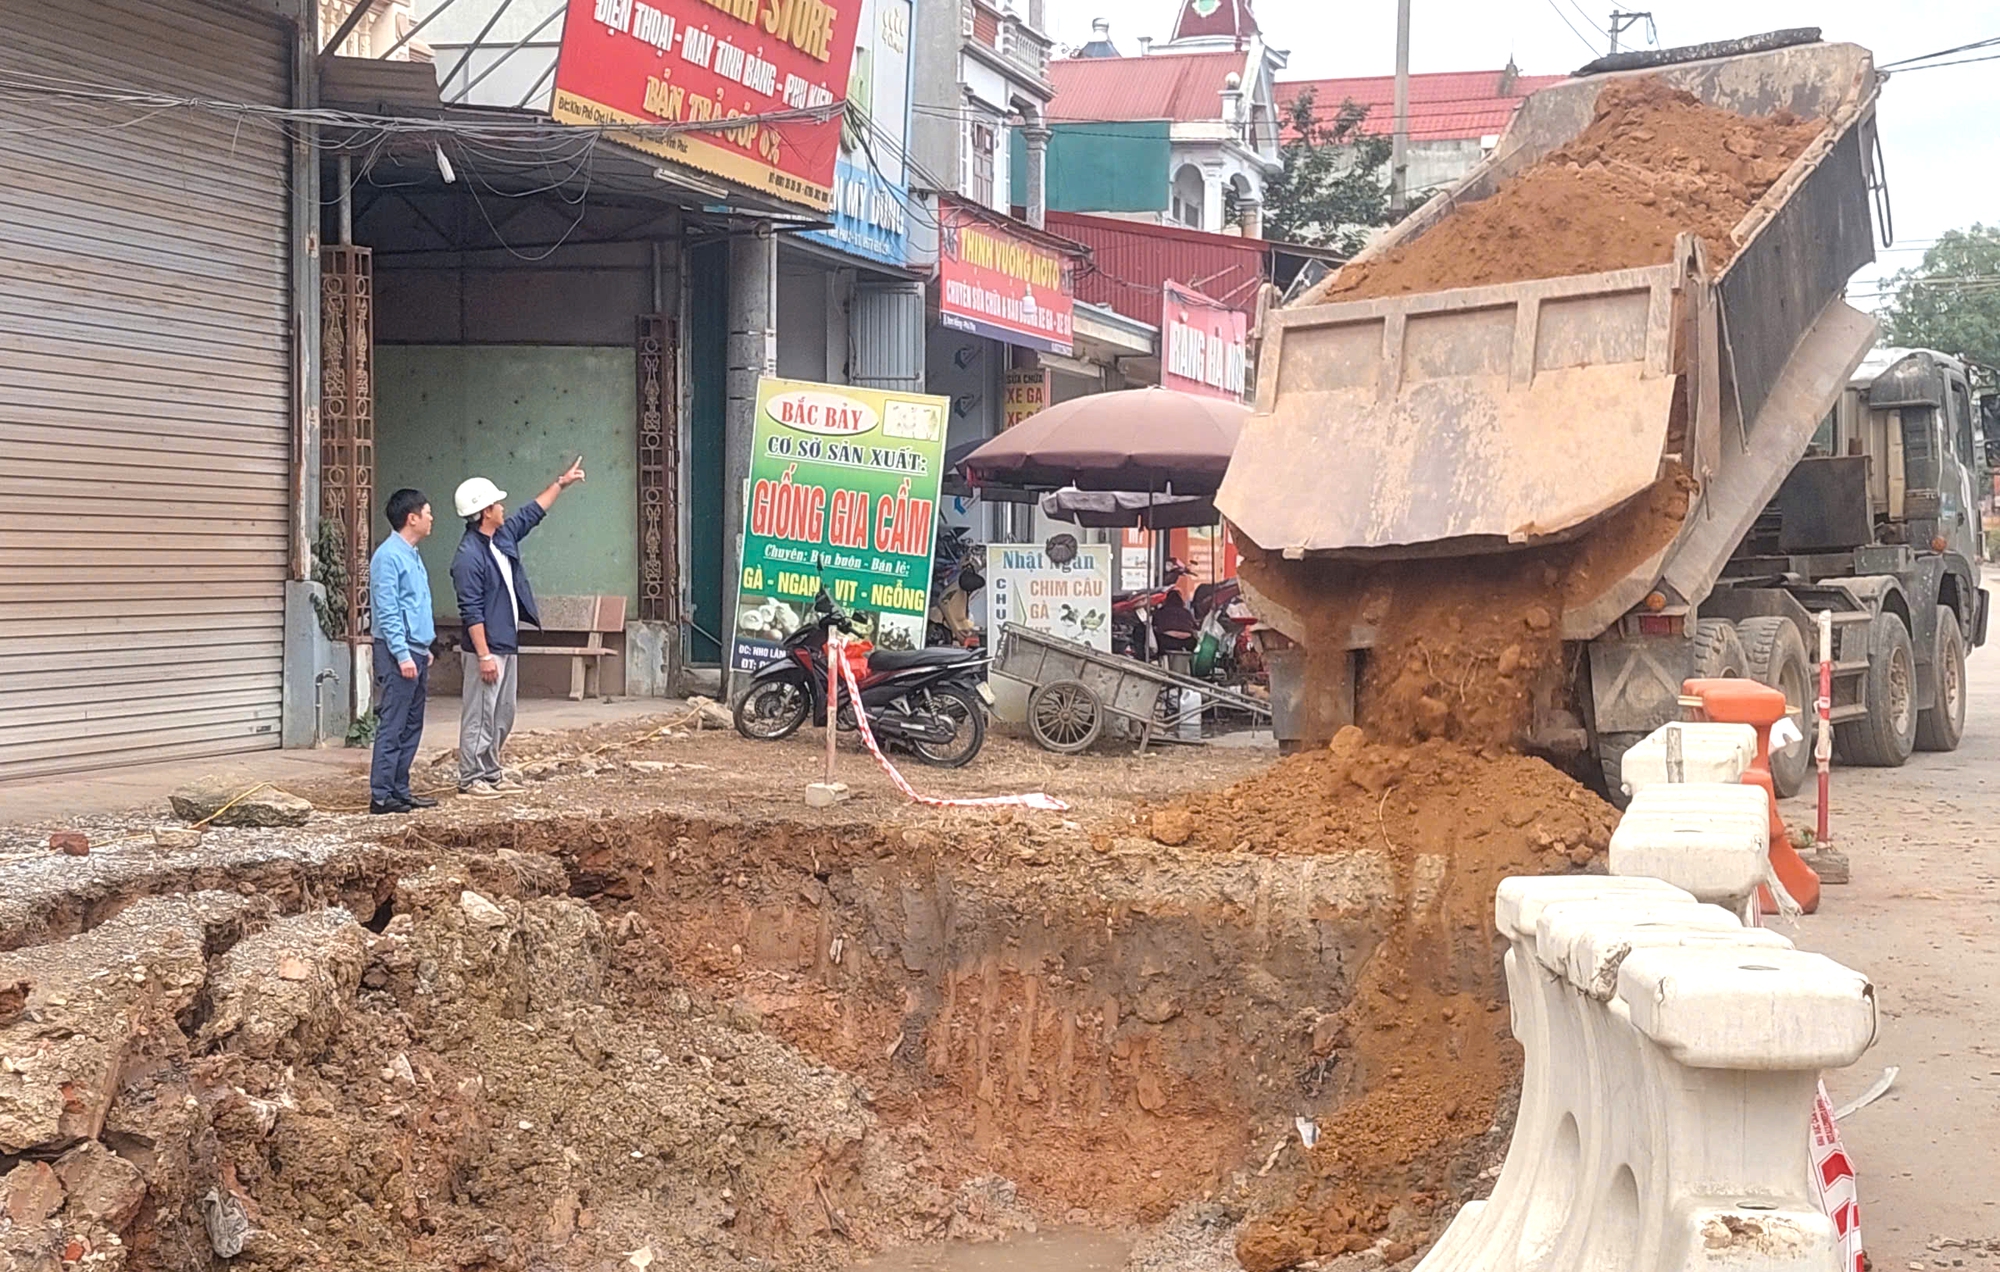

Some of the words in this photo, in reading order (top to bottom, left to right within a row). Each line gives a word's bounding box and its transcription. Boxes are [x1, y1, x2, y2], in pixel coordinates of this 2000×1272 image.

[631, 1, 676, 57] THOẠI
[681, 24, 715, 69] MÁY
[714, 35, 745, 82] TÍNH
[742, 46, 777, 97] BẢNG
[961, 227, 994, 275] THỊNH
[1007, 387, 1022, 404] XE
[1027, 387, 1043, 404] GA
[781, 396, 818, 425] BẮC
[768, 436, 792, 454] CƠ
[798, 437, 822, 458] SỞ
[828, 441, 864, 464] SẢN
[870, 447, 927, 472] XUẤT:
[752, 464, 826, 543] GIỐNG
[829, 489, 869, 549] GIA
[875, 478, 932, 557] CẦM
[764, 544, 808, 562] Chuyên:
[834, 552, 861, 569] buôn
[871, 557, 892, 573] Bán
[1003, 550, 1044, 573] Nhật
[743, 563, 763, 590] GÀ
[835, 579, 858, 606] VỊT
[870, 580, 925, 611] NGỖNG
[1030, 580, 1068, 597] CHIM
[1073, 577, 1102, 597] CÂU
[1030, 600, 1049, 619] GÀ
